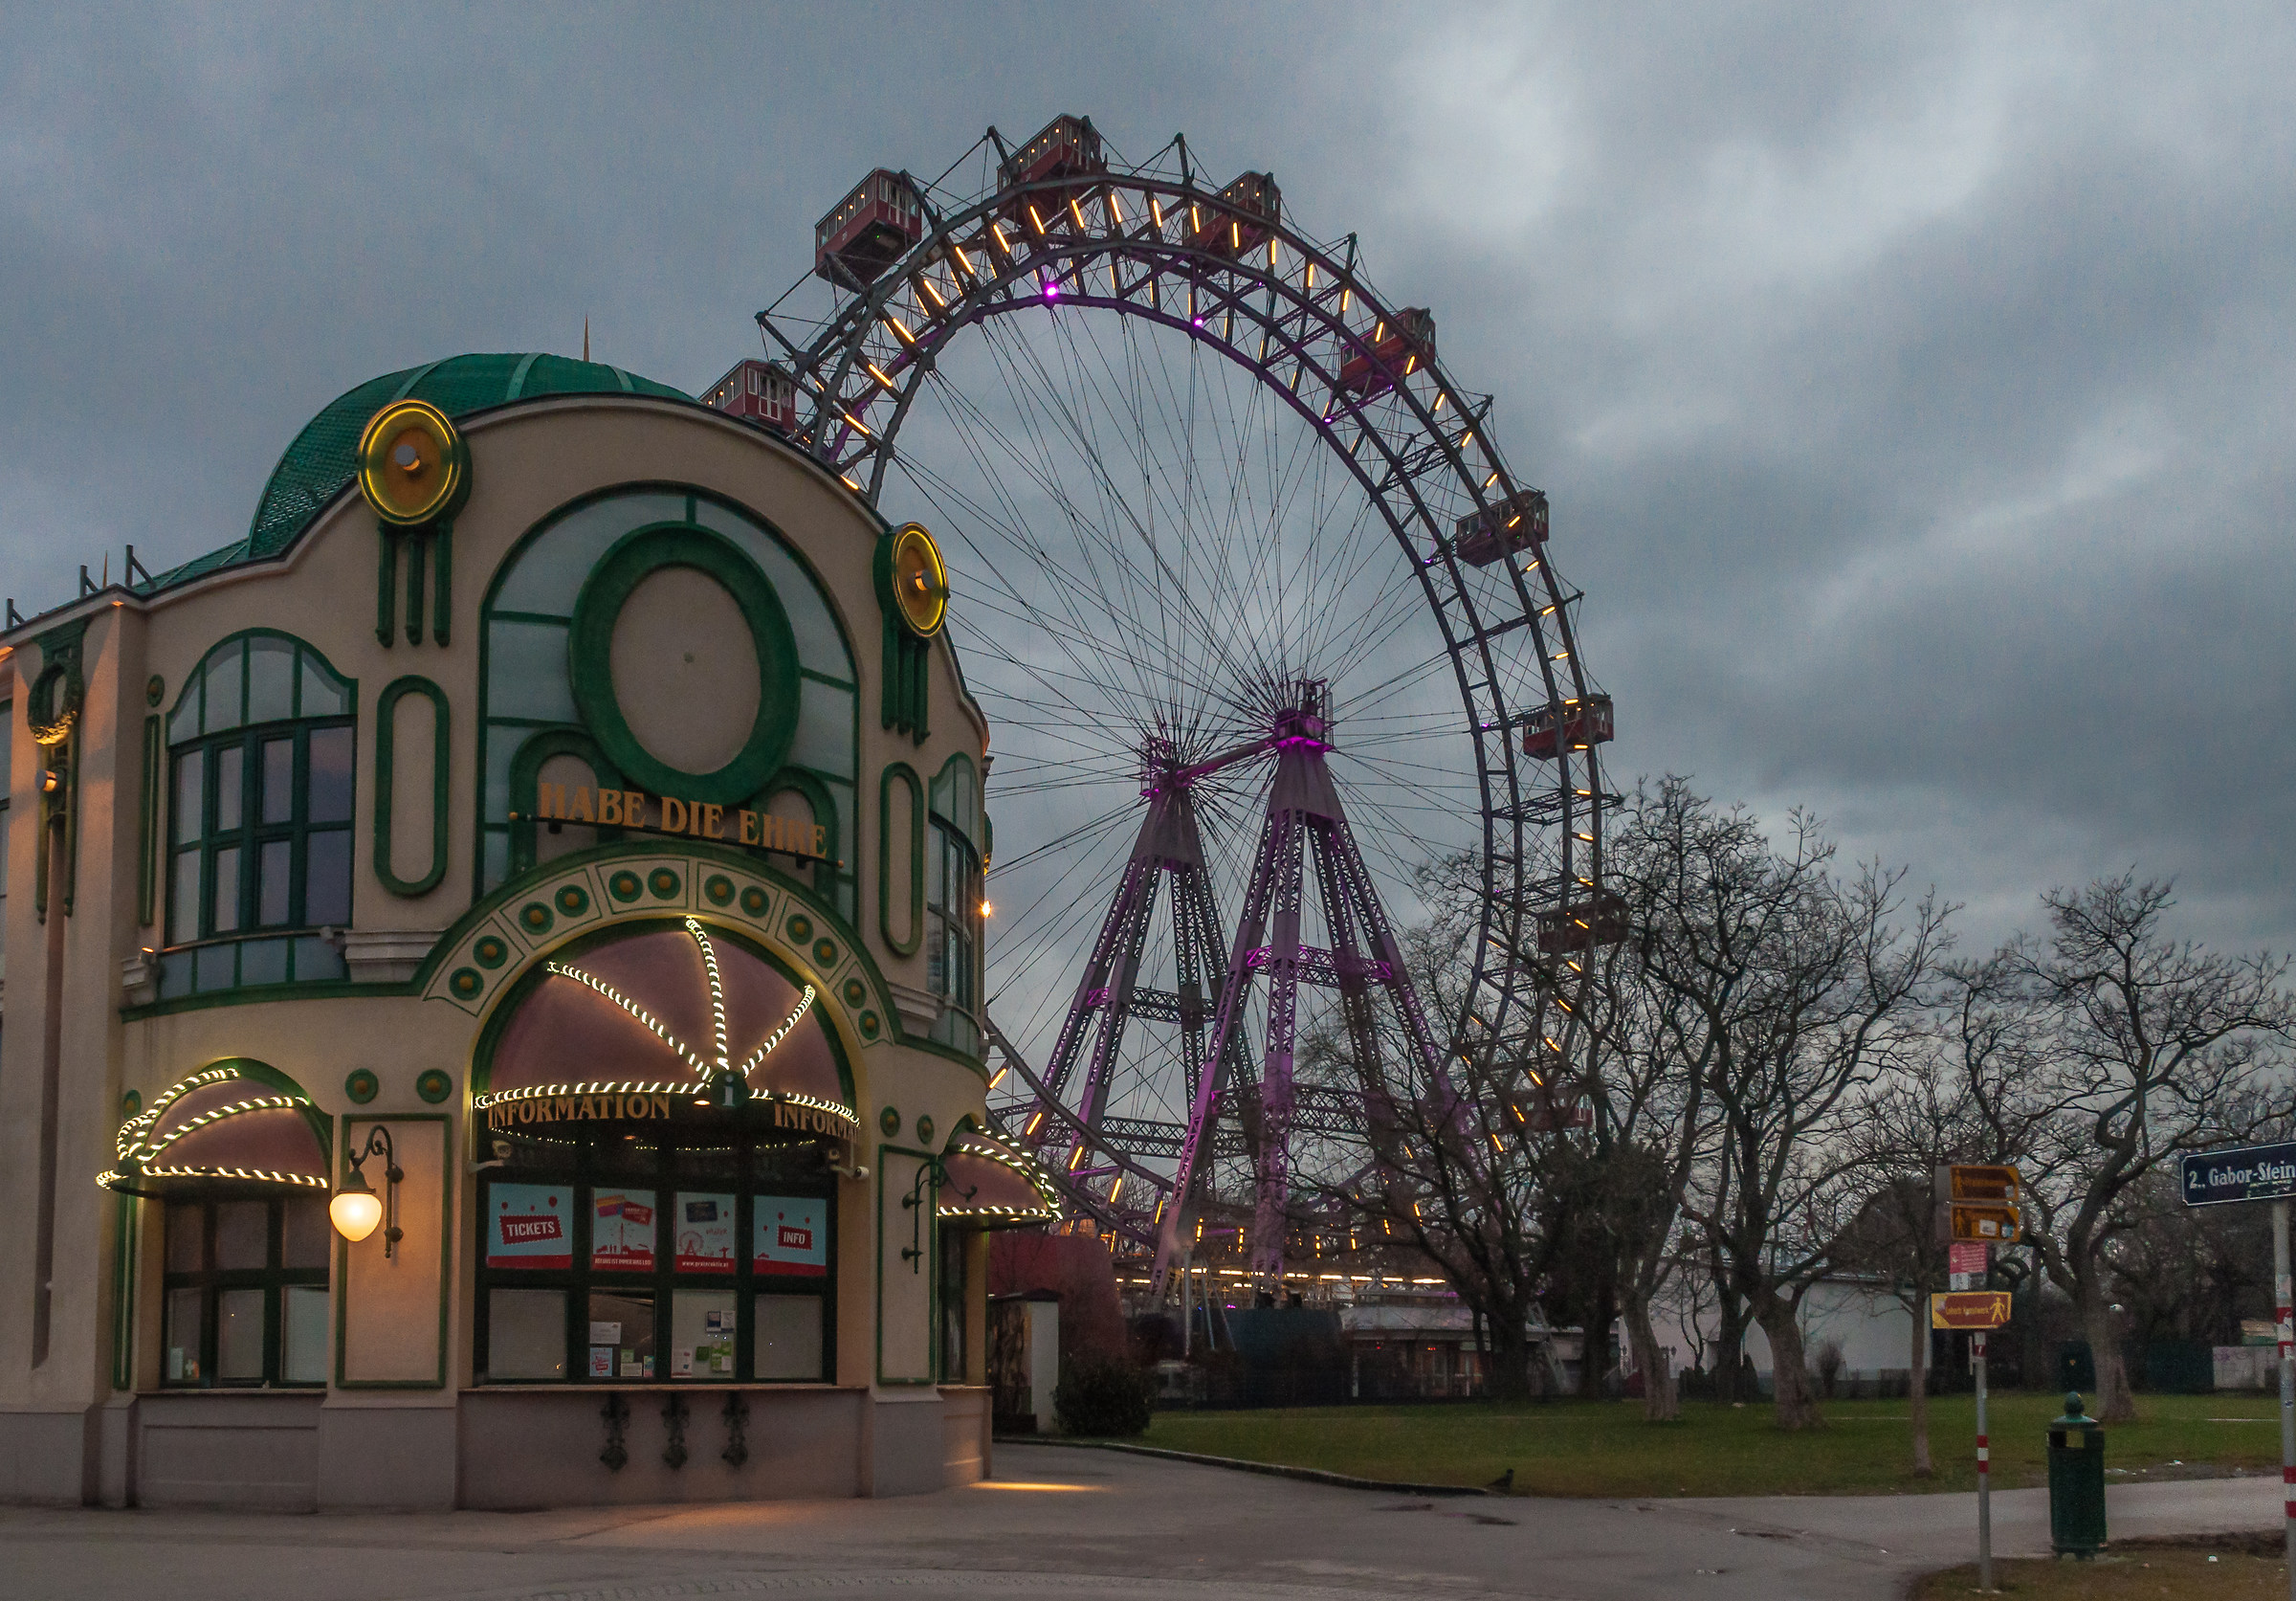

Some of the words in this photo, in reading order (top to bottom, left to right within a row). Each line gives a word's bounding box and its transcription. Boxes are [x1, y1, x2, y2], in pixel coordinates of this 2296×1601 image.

[538, 782, 648, 829] HABE
[660, 796, 725, 840] DIE
[739, 809, 828, 860] EHRE
[487, 1094, 671, 1129] INFORMATION
[2207, 1160, 2296, 1188] Gabor-Stein
[506, 1221, 556, 1237] TICKETS
[783, 1231, 806, 1245] INFO
